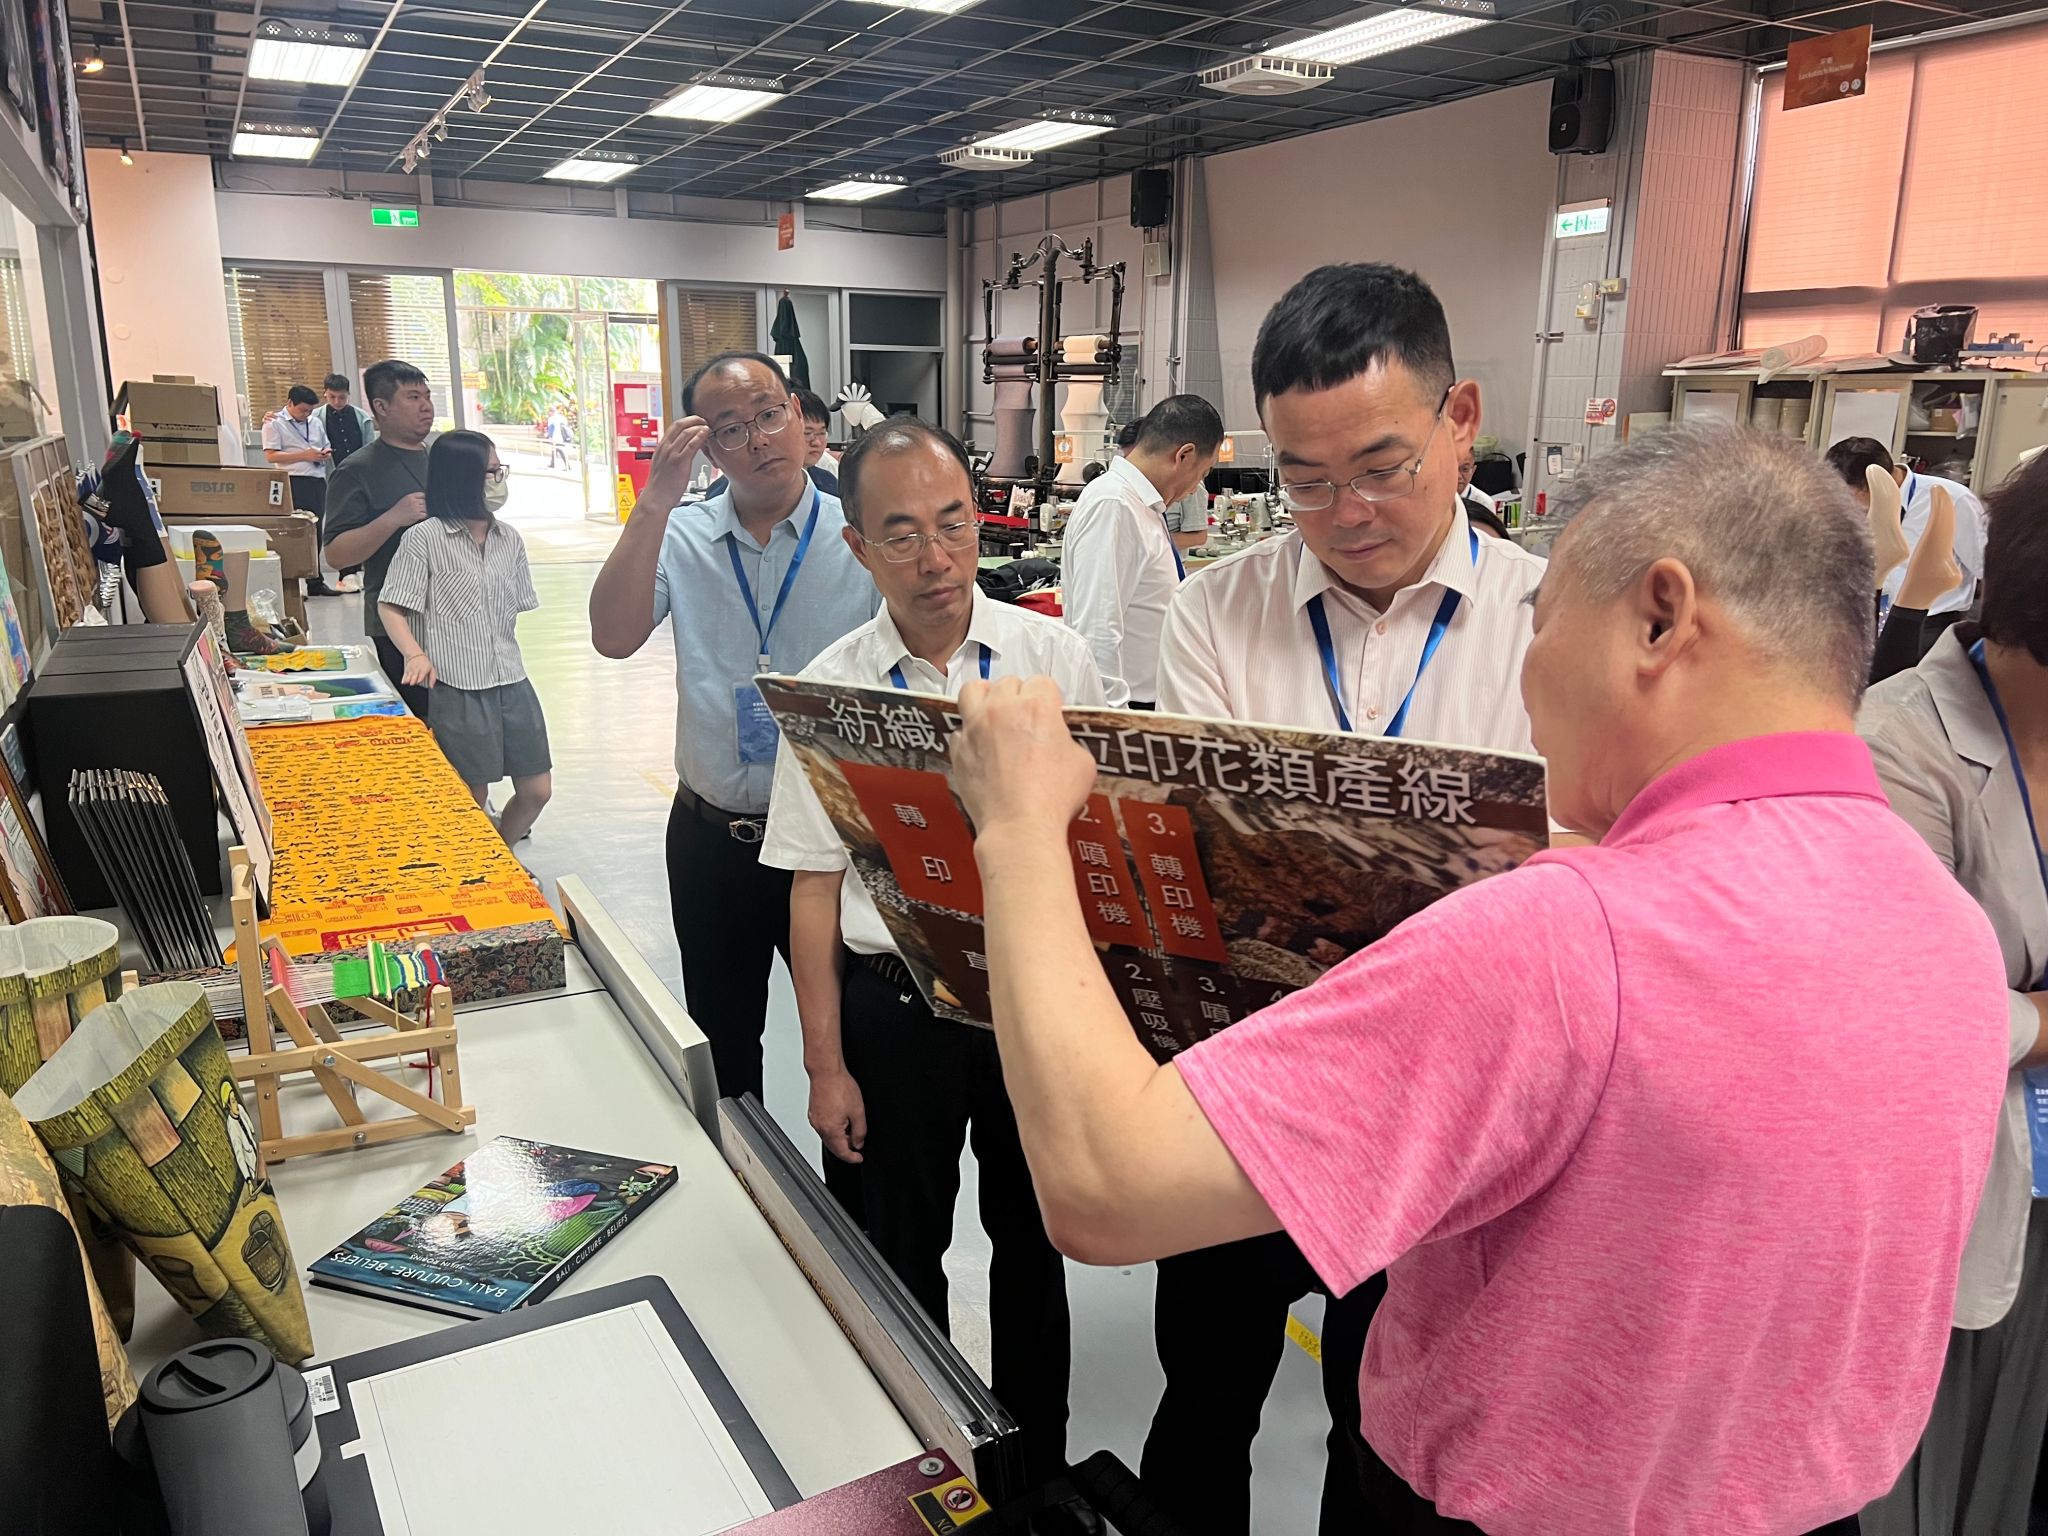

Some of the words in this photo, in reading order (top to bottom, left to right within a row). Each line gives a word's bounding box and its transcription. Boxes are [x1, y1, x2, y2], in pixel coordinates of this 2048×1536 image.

[1076, 839, 1132, 925] 噴印機
[1150, 853, 1206, 939] 轉印機
[330, 1251, 389, 1272] BELIEFS
[556, 1264, 571, 1281] BALI
[575, 1234, 603, 1264] CULTURE
[606, 1213, 628, 1238] BELIEFS
[392, 1265, 463, 1288] CULTURE
[468, 1282, 508, 1298] BALI
